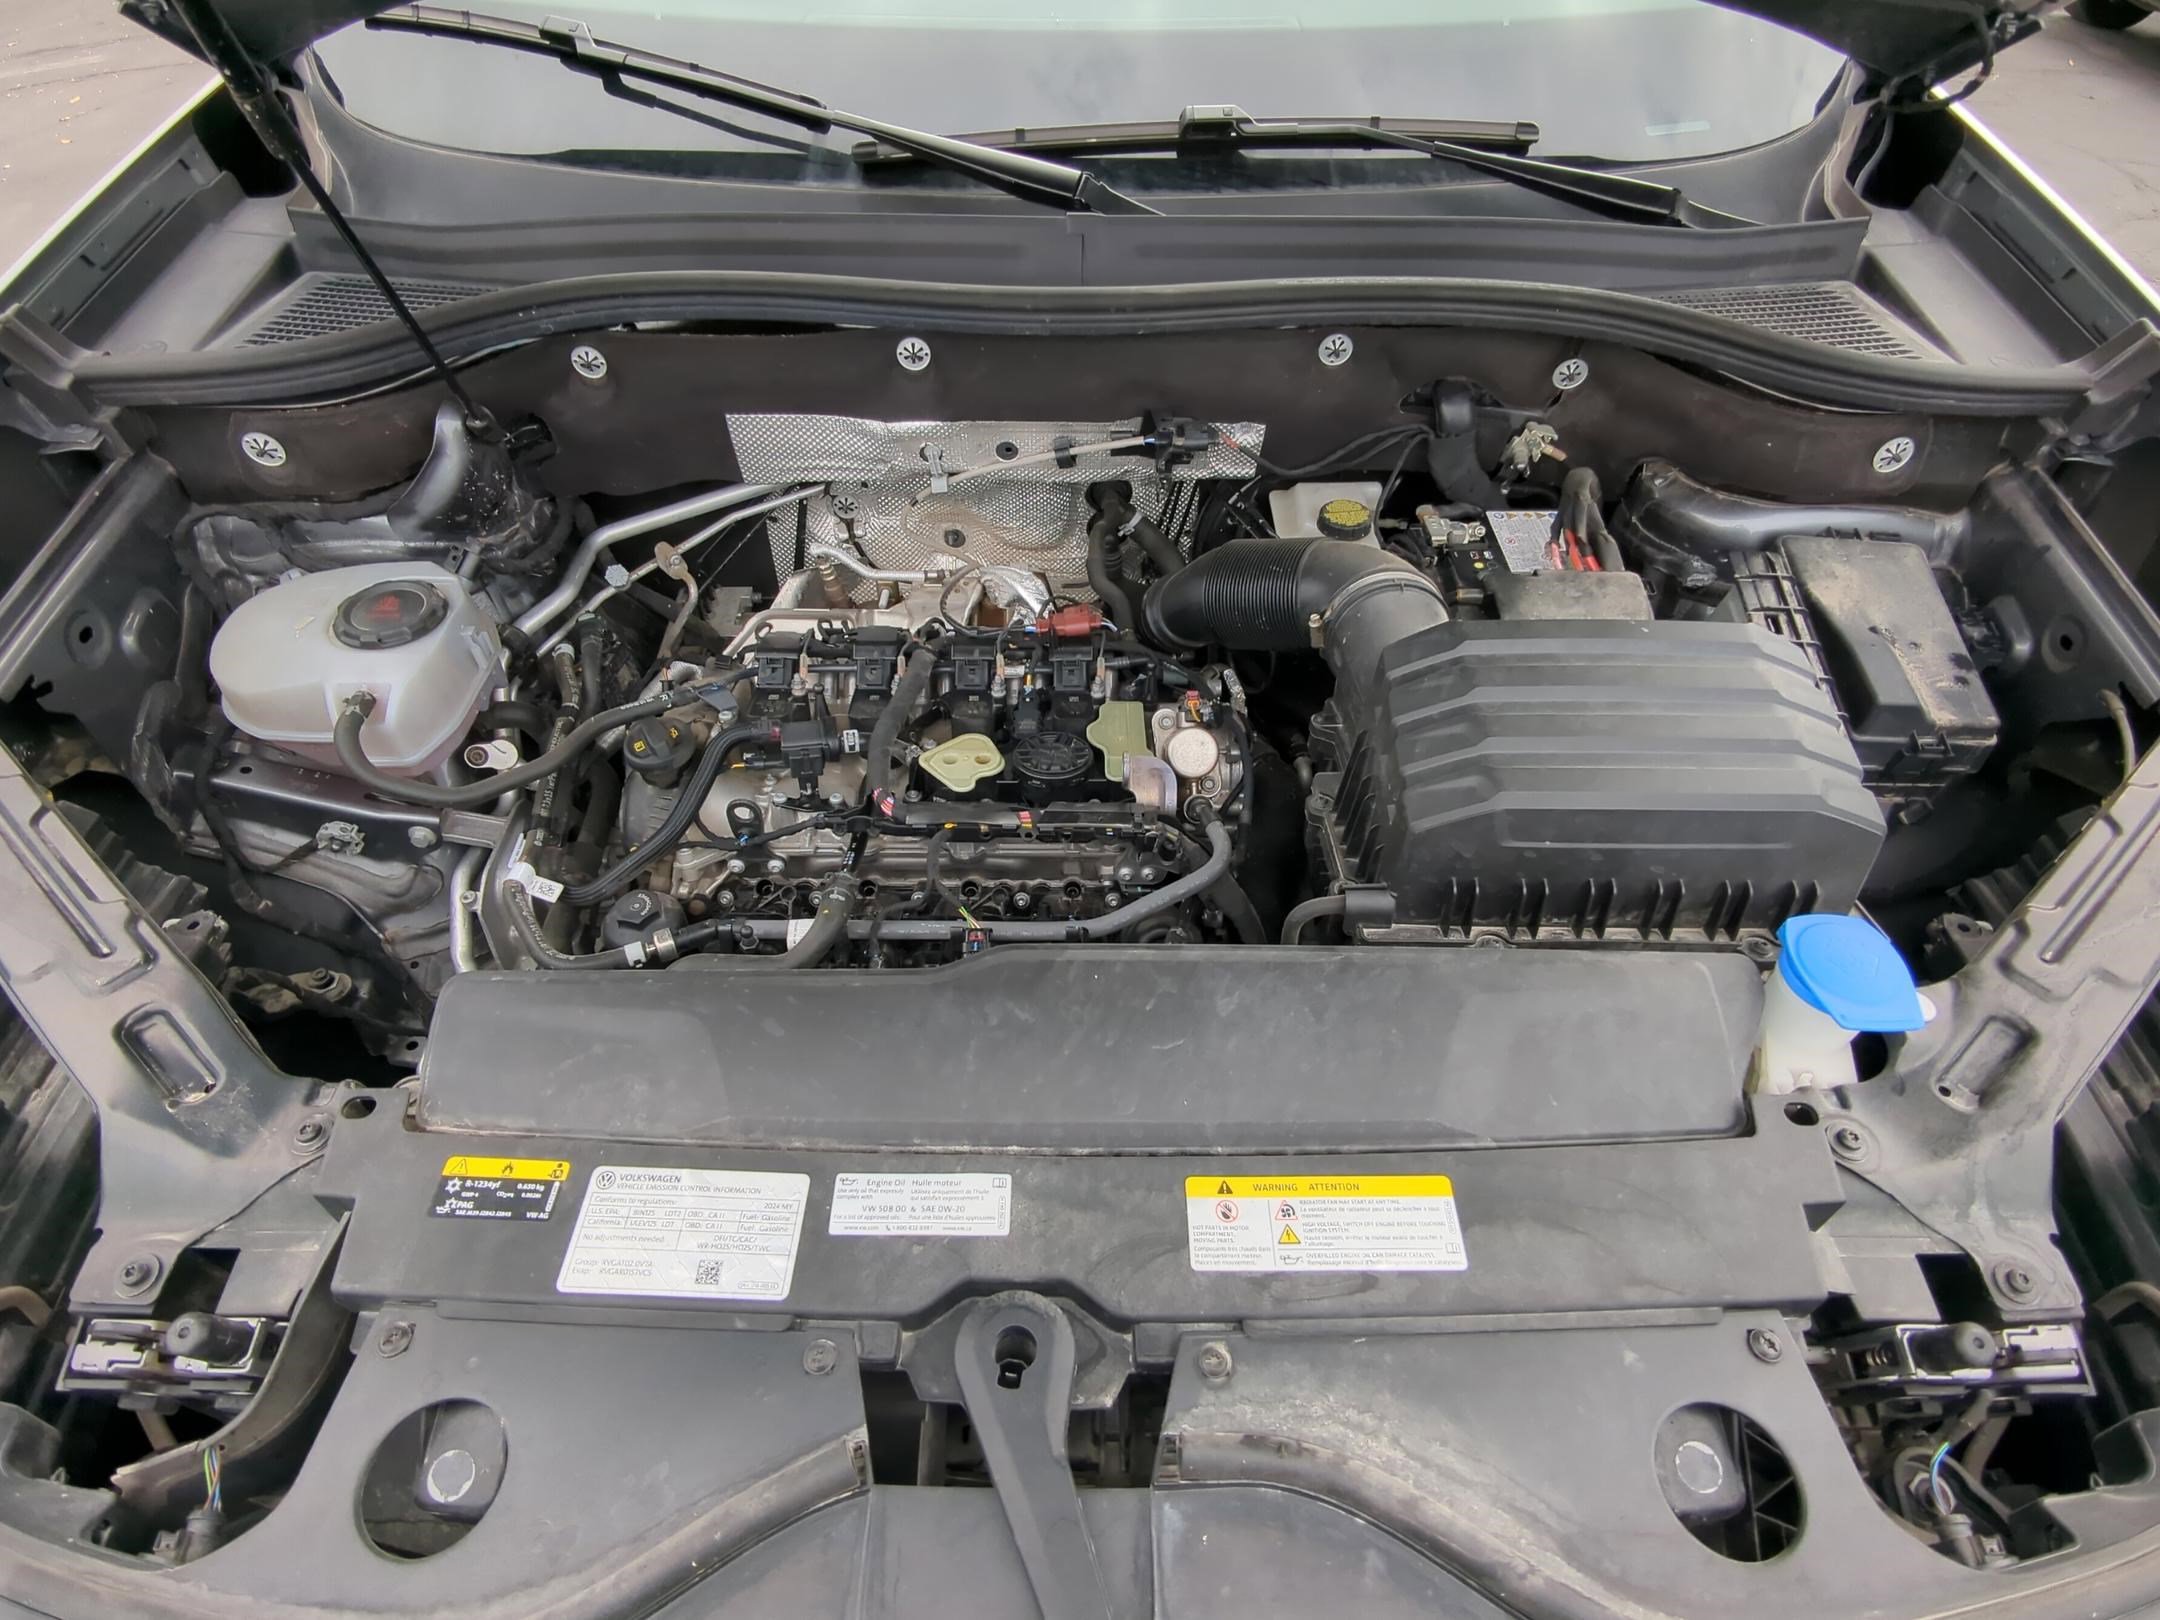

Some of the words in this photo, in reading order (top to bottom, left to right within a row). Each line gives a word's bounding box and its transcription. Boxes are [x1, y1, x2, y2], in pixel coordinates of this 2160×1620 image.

[619, 1173, 681, 1183] VOLKSWAGEN
[867, 1179, 894, 1188] Engine
[1252, 1183, 1298, 1191] WARNING
[1308, 1183, 1360, 1191] ATTENTION
[536, 1184, 545, 1192] kg
[617, 1182, 643, 1190] VEHICLE
[645, 1184, 679, 1192] EMISSION
[713, 1186, 761, 1194] INFORMATION
[863, 1205, 877, 1213] VW
